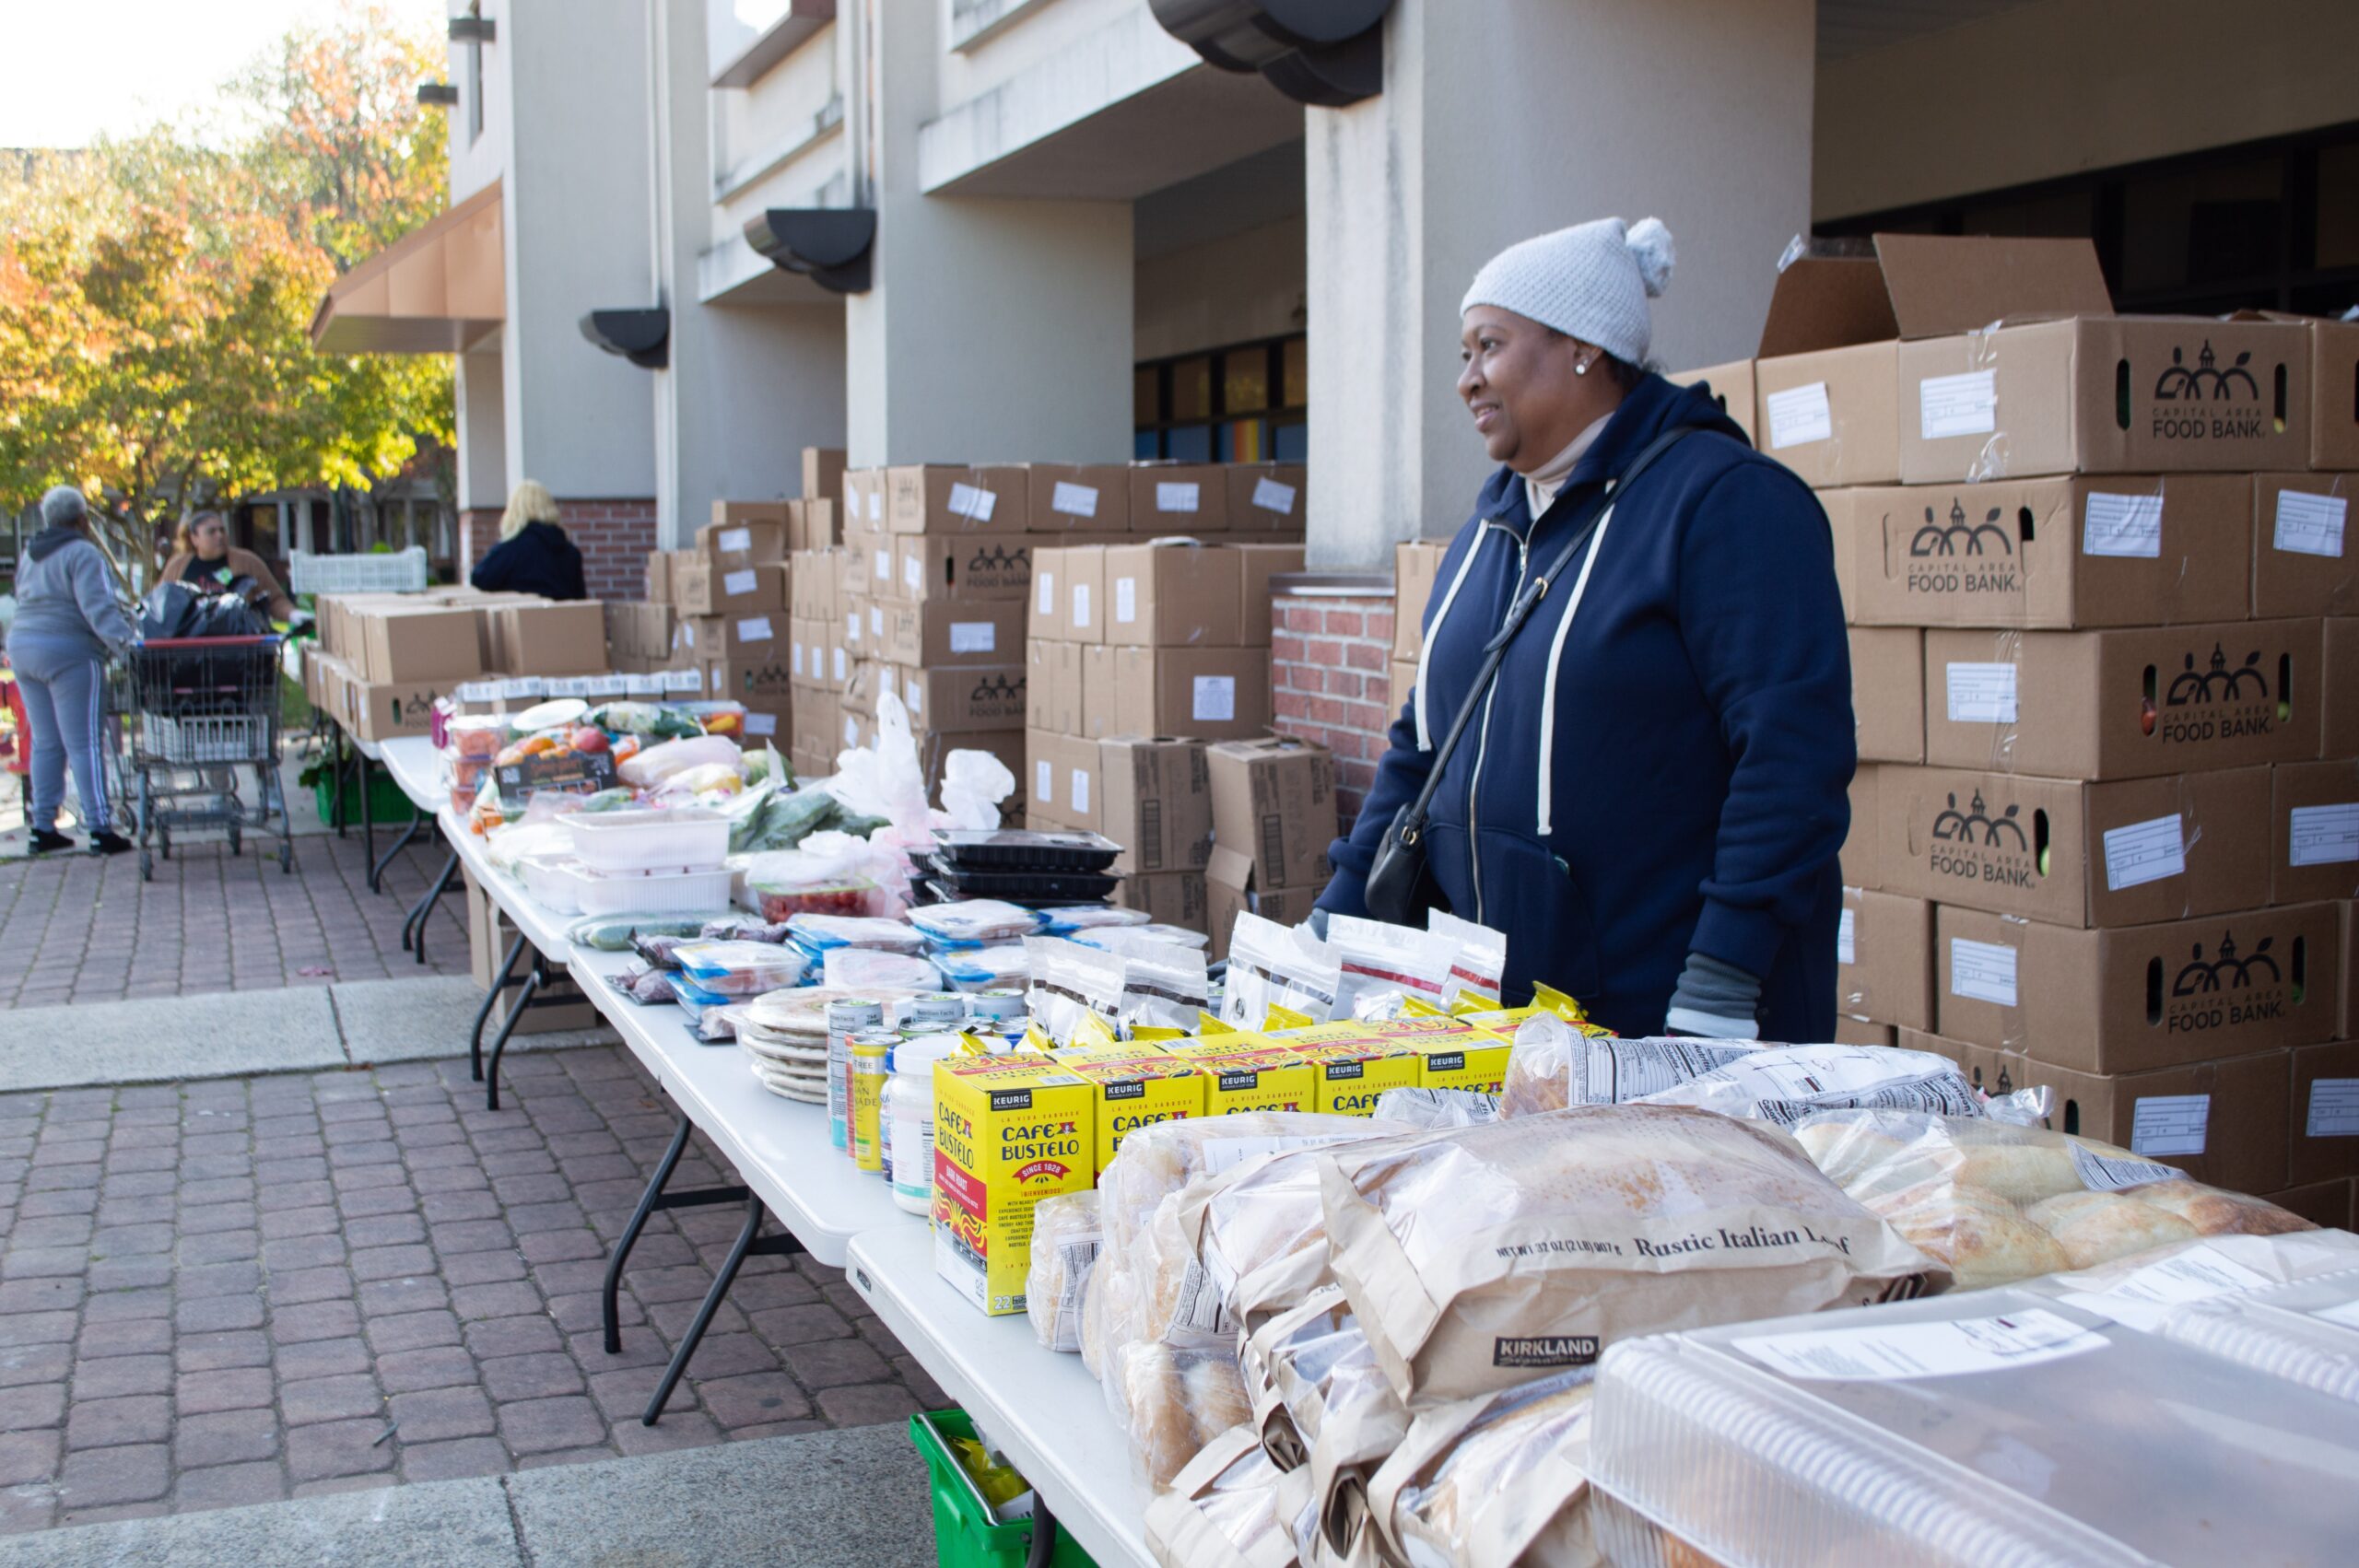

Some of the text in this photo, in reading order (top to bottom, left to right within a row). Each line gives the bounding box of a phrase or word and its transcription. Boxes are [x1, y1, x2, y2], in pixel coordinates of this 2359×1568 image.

[2153, 408, 2260, 417] CAPITAL AREA
[2153, 419, 2205, 439] FOOD
[1907, 563, 2015, 572] CAPITAL AREA
[1003, 576, 1030, 587] BAN
[1908, 574, 1958, 592] FOOD
[1005, 705, 1026, 716] BA
[2163, 721, 2213, 744] FOOD
[1931, 844, 2030, 868] CAPITAL AREA
[1931, 855, 1977, 878] FOOD
[2169, 1010, 2223, 1035] FOOD
[1430, 1056, 1463, 1067] KEURIG
[1663, 1044, 1680, 1069] Calories
[1694, 1043, 1711, 1071] Nutritio
[1328, 1064, 1361, 1075] KEURIG
[1108, 1084, 1143, 1094] KEURIG
[1221, 1075, 1255, 1085] KEURIG
[993, 1094, 1029, 1106] KEURIG
[1763, 1099, 1781, 1126] Calori
[939, 1126, 974, 1170] BUSTELO
[1002, 1140, 1079, 1161] BUSTELO
[1022, 1164, 1061, 1177] SINCE 1928
[1496, 1246, 1517, 1258] NET
[1517, 1246, 1533, 1257] WT
[1535, 1242, 1550, 1253] 32
[1550, 1240, 1565, 1252] OZ
[1593, 1242, 1612, 1253] 907
[1614, 1246, 1622, 1256] g
[1633, 1234, 1716, 1258] Rustic
[1718, 1226, 1801, 1249] Italian
[994, 1296, 1011, 1310] 22
[1500, 1339, 1595, 1356] KIRKLAND
